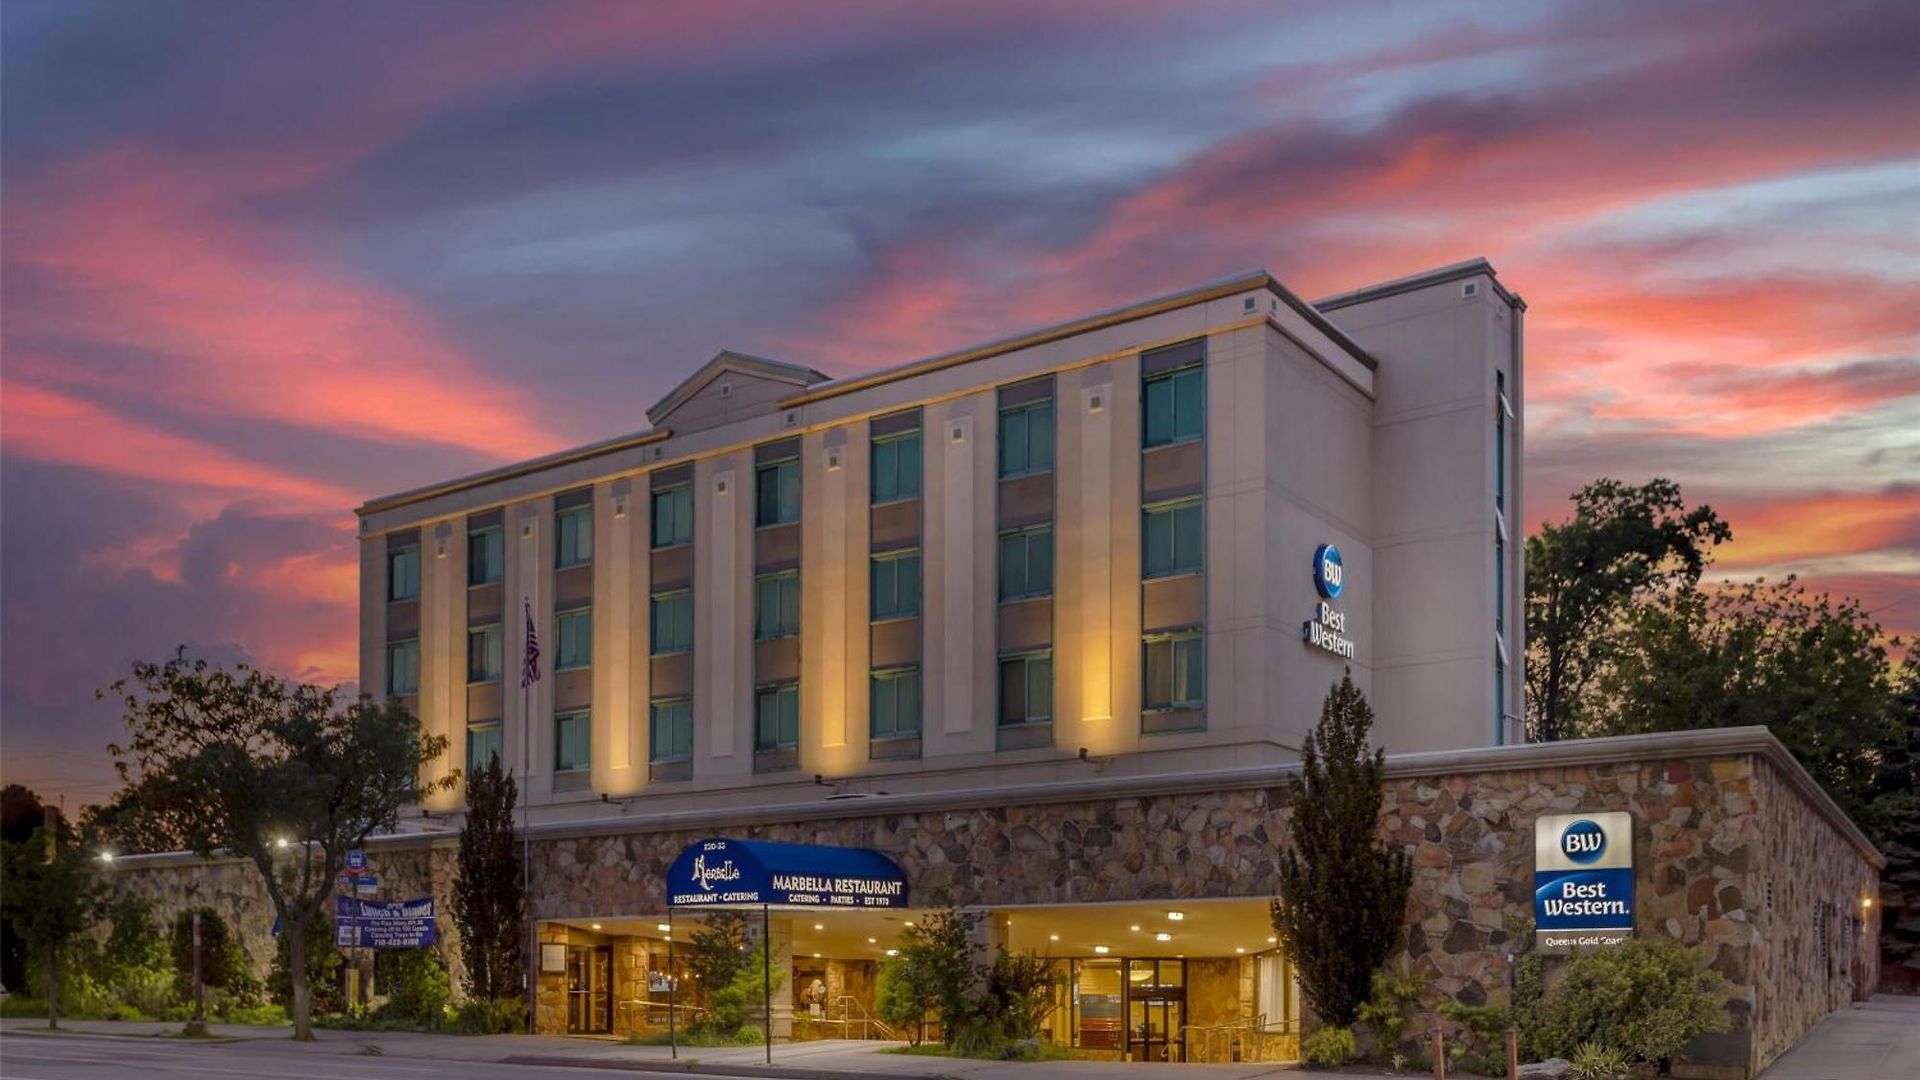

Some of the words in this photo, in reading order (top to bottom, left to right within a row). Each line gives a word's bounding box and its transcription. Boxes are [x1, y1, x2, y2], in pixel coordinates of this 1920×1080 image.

[1324, 559, 1342, 586] BW
[1321, 601, 1345, 632] Best
[1310, 621, 1354, 659] Western
[1566, 832, 1602, 853] BW
[772, 875, 831, 893] MARBELLA
[834, 878, 902, 896] RESTAURANT
[1562, 881, 1606, 898] Best
[673, 893, 718, 904] RESTAURANT
[722, 891, 759, 902] CATERING
[788, 893, 820, 903] CATERING
[830, 895, 854, 905] PARTIES
[1578, 936, 1599, 945] Gold
